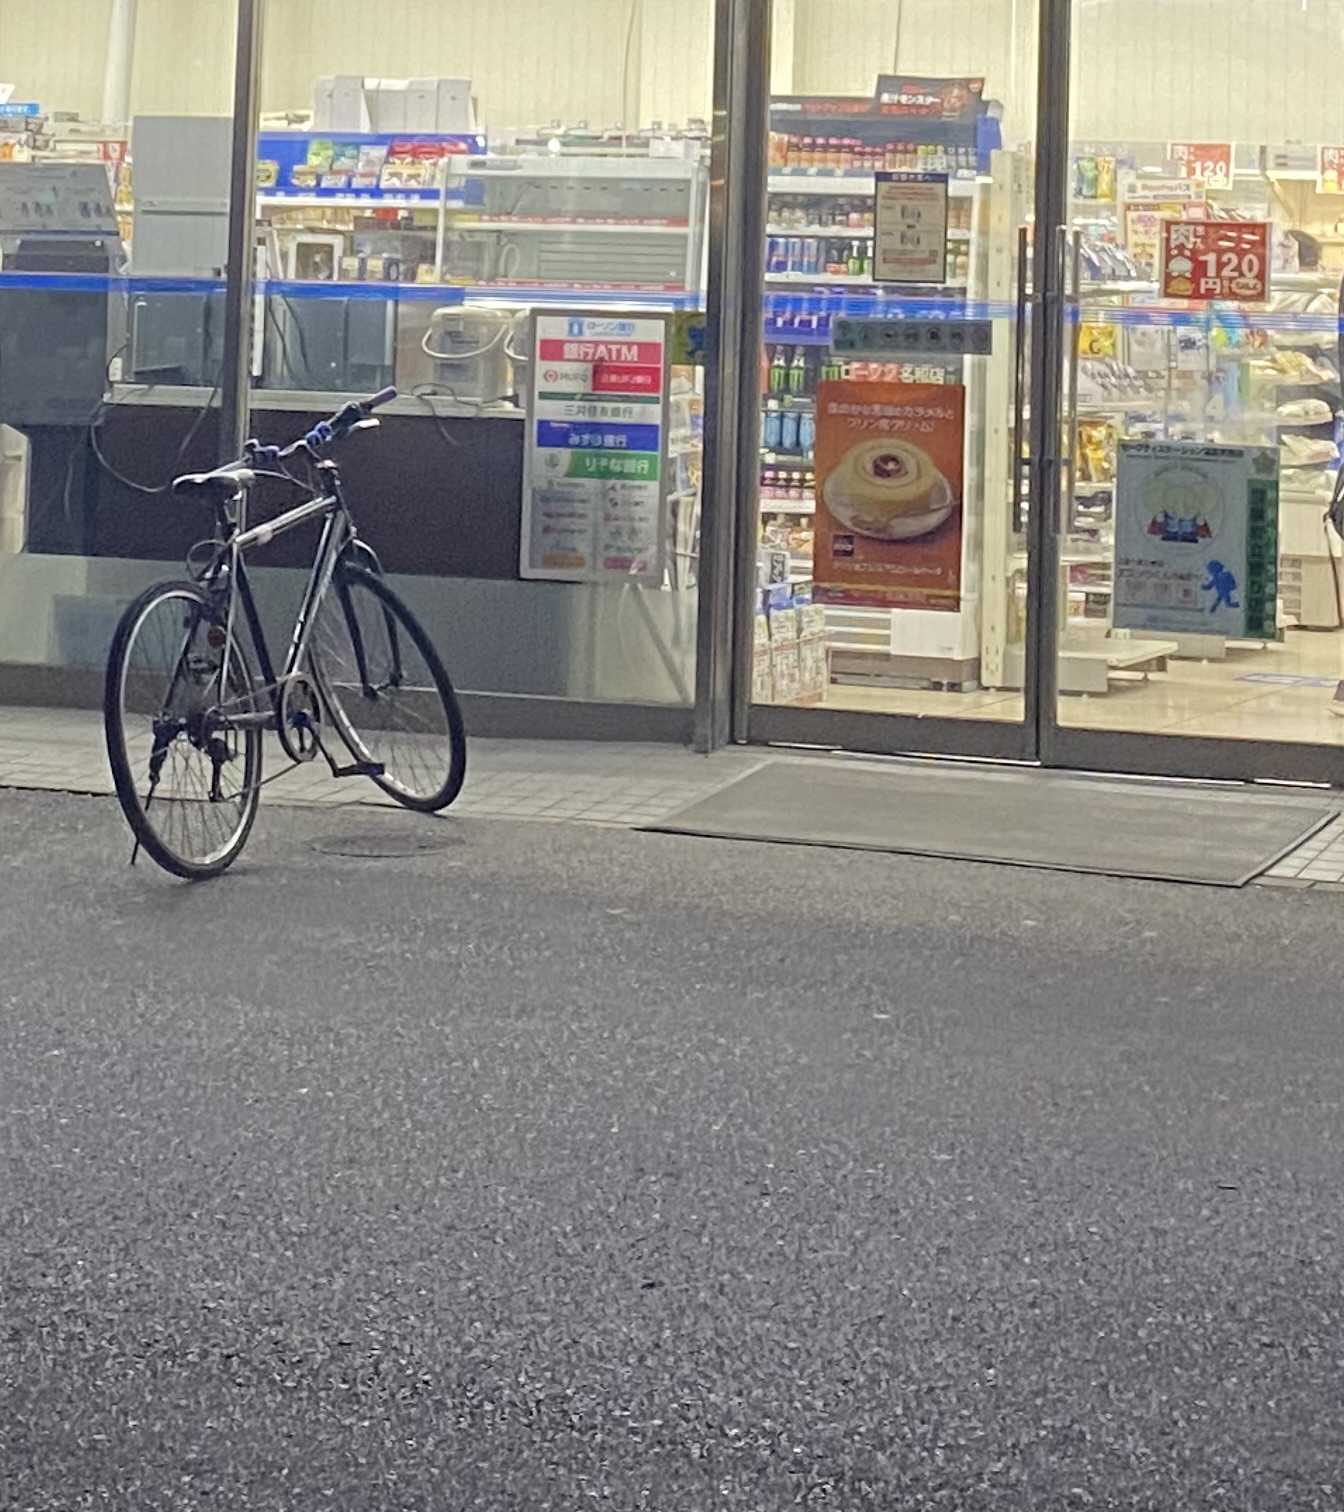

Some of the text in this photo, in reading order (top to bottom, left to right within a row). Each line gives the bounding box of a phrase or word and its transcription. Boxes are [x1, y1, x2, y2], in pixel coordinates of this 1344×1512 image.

[1199, 252, 1260, 279] 120
[1199, 277, 1222, 295] 円
[563, 343, 639, 362] 銀行ATM
[585, 456, 649, 475] りそな銀行
